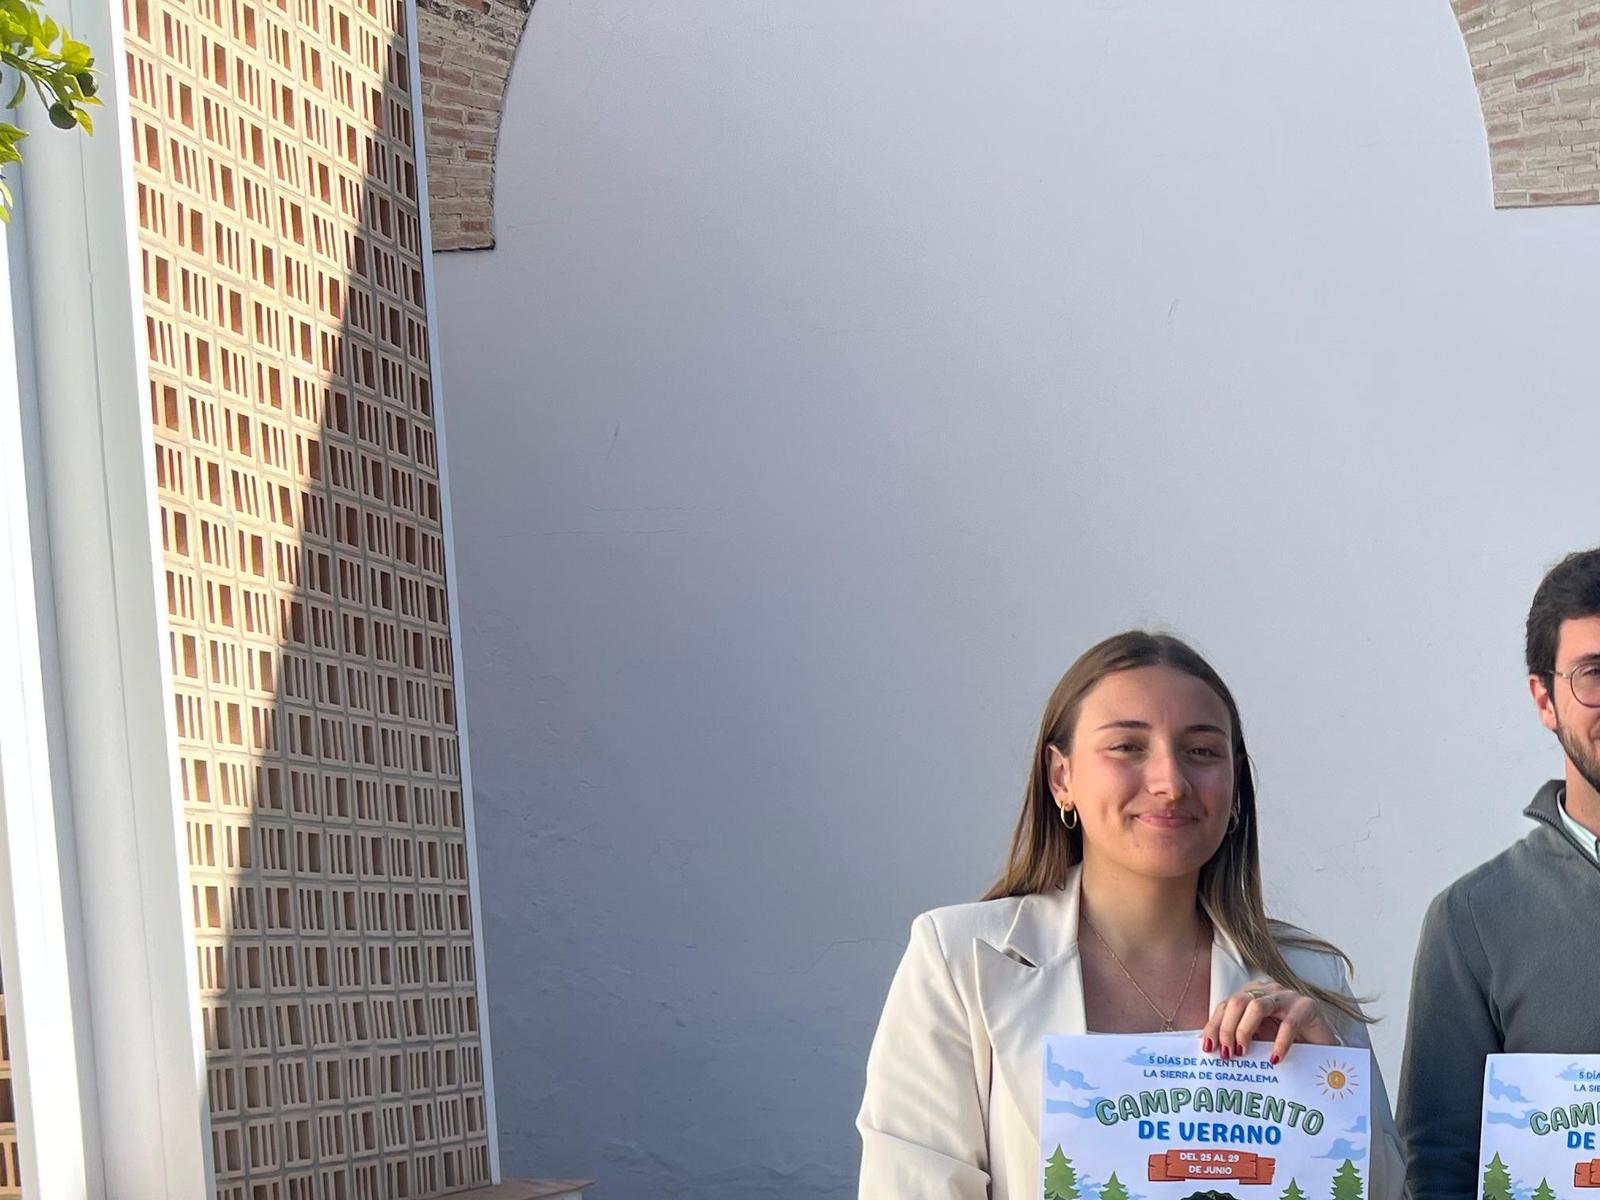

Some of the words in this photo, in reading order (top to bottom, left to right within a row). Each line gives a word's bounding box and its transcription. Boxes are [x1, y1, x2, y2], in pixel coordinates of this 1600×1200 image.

[1149, 1056, 1155, 1064] 5
[1156, 1055, 1181, 1066] DÍAS
[1183, 1057, 1197, 1066] DE
[1200, 1058, 1259, 1070] AVENTURA
[1260, 1061, 1274, 1070] EN
[1143, 1070, 1157, 1078] LA
[1159, 1070, 1197, 1080] SIERRA
[1199, 1072, 1213, 1081] DE
[1214, 1072, 1279, 1084] GRAZALEMA
[1579, 1071, 1584, 1079] 5
[1573, 1084, 1586, 1092] LA
[1095, 1087, 1324, 1136] CAMPAMENTO
[1138, 1120, 1170, 1140] DE
[1179, 1122, 1281, 1145] VERANO
[1567, 1131, 1596, 1150] DE
[1179, 1152, 1198, 1162] DEL
[1200, 1153, 1212, 1162] 25
[1213, 1153, 1226, 1163] AL
[1228, 1154, 1240, 1163] 29
[1188, 1165, 1201, 1174] DE
[1203, 1166, 1233, 1176] JUNIO
